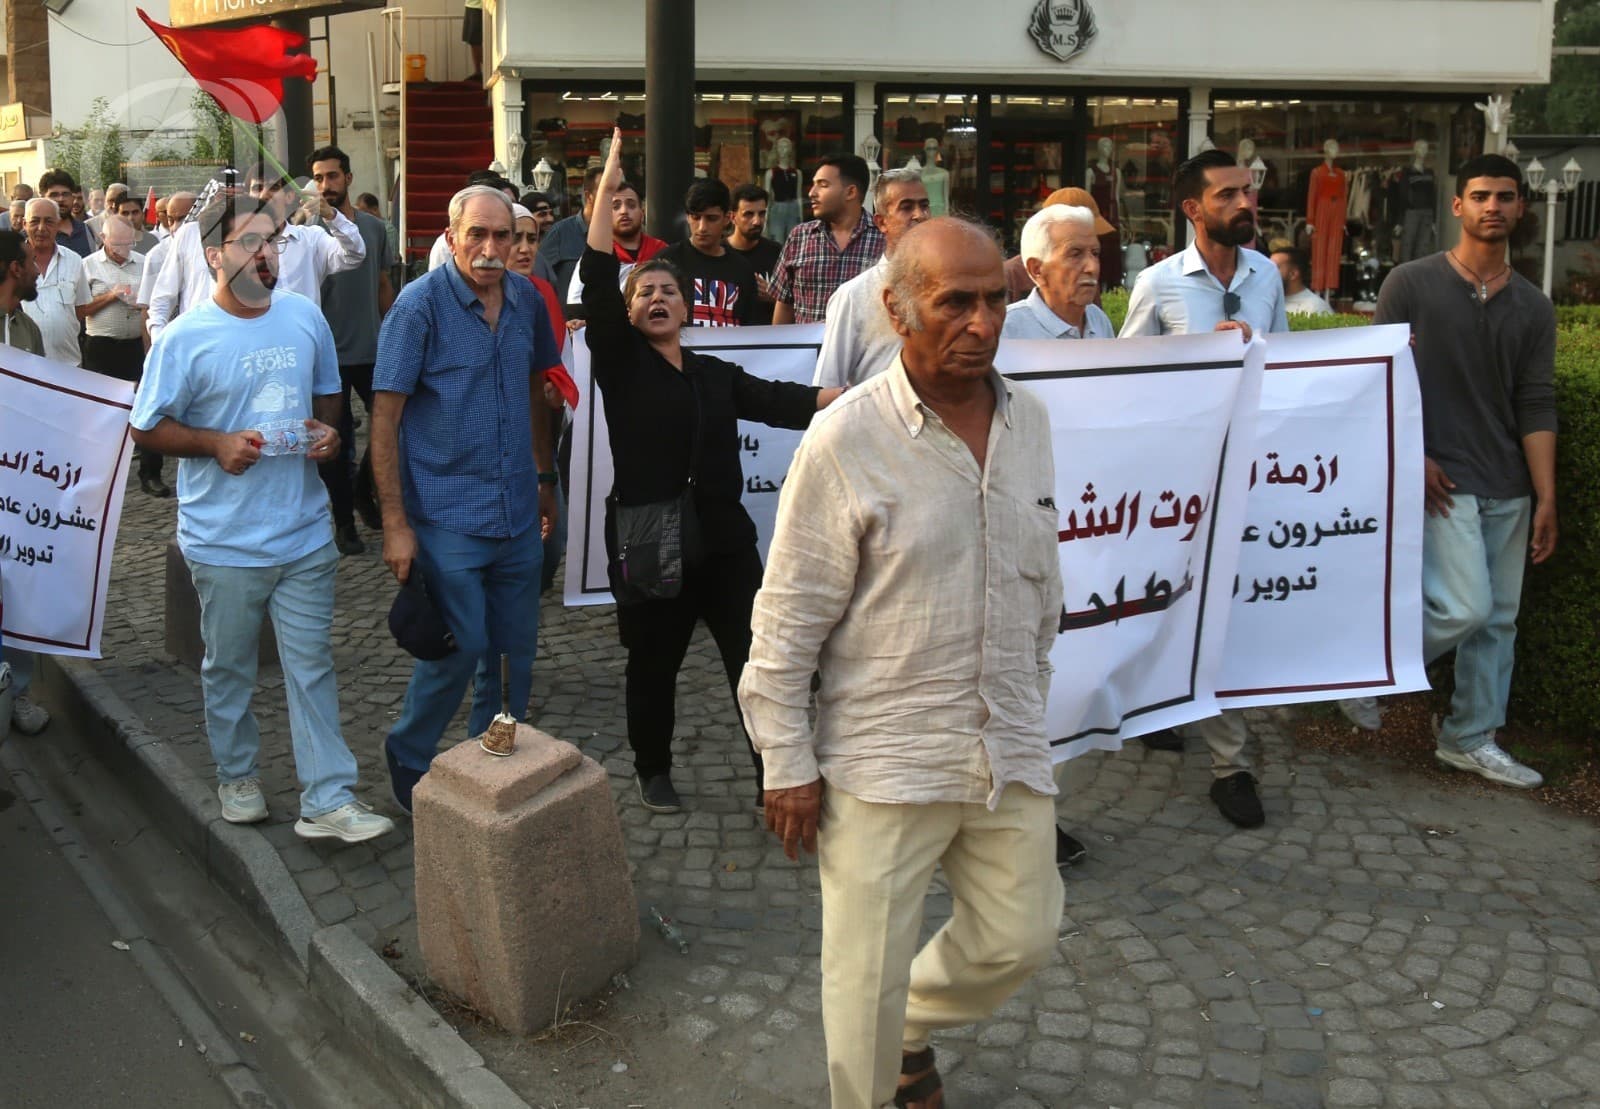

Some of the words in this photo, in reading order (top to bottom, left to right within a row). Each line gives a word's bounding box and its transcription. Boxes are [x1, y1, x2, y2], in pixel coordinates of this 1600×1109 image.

[1053, 33, 1077, 46] M.S
[256, 352, 297, 374] SONS
[1266, 452, 1339, 493] ازمة
[25, 502, 97, 532] عشرون
[1268, 506, 1379, 549] عشرون
[12, 543, 55, 567] تدوير
[1244, 566, 1318, 603] تدوير
